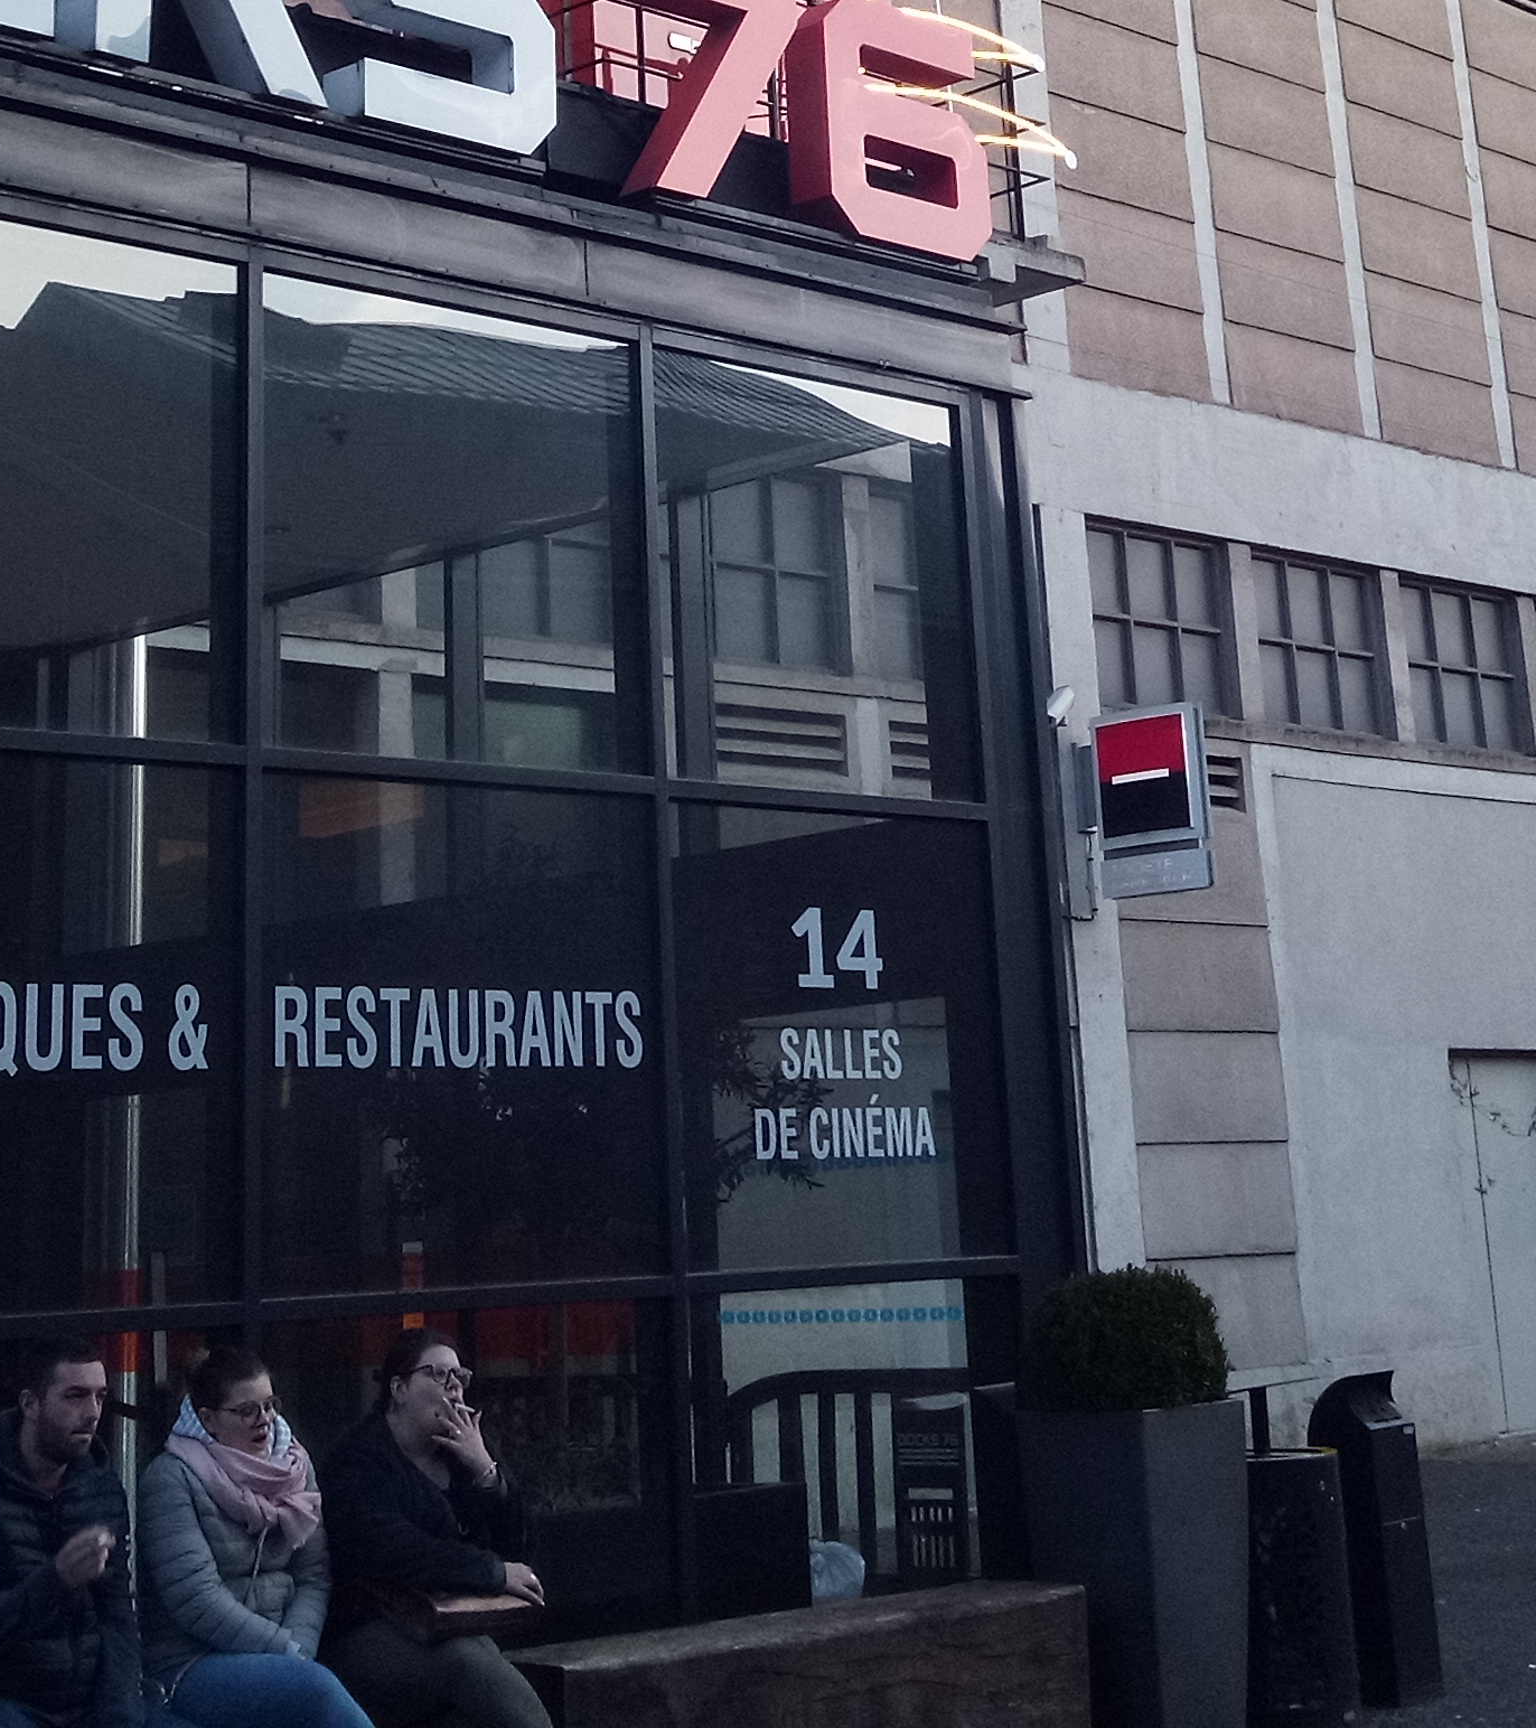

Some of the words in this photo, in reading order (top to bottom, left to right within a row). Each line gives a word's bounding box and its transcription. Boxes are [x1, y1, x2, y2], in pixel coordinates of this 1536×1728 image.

[790, 906, 884, 990] 14
[167, 983, 209, 1072] &
[274, 985, 644, 1069] RESTAURANTS
[779, 1027, 903, 1081] SALLES
[754, 1107, 799, 1160] DE
[809, 1094, 937, 1160] CINÉMA
